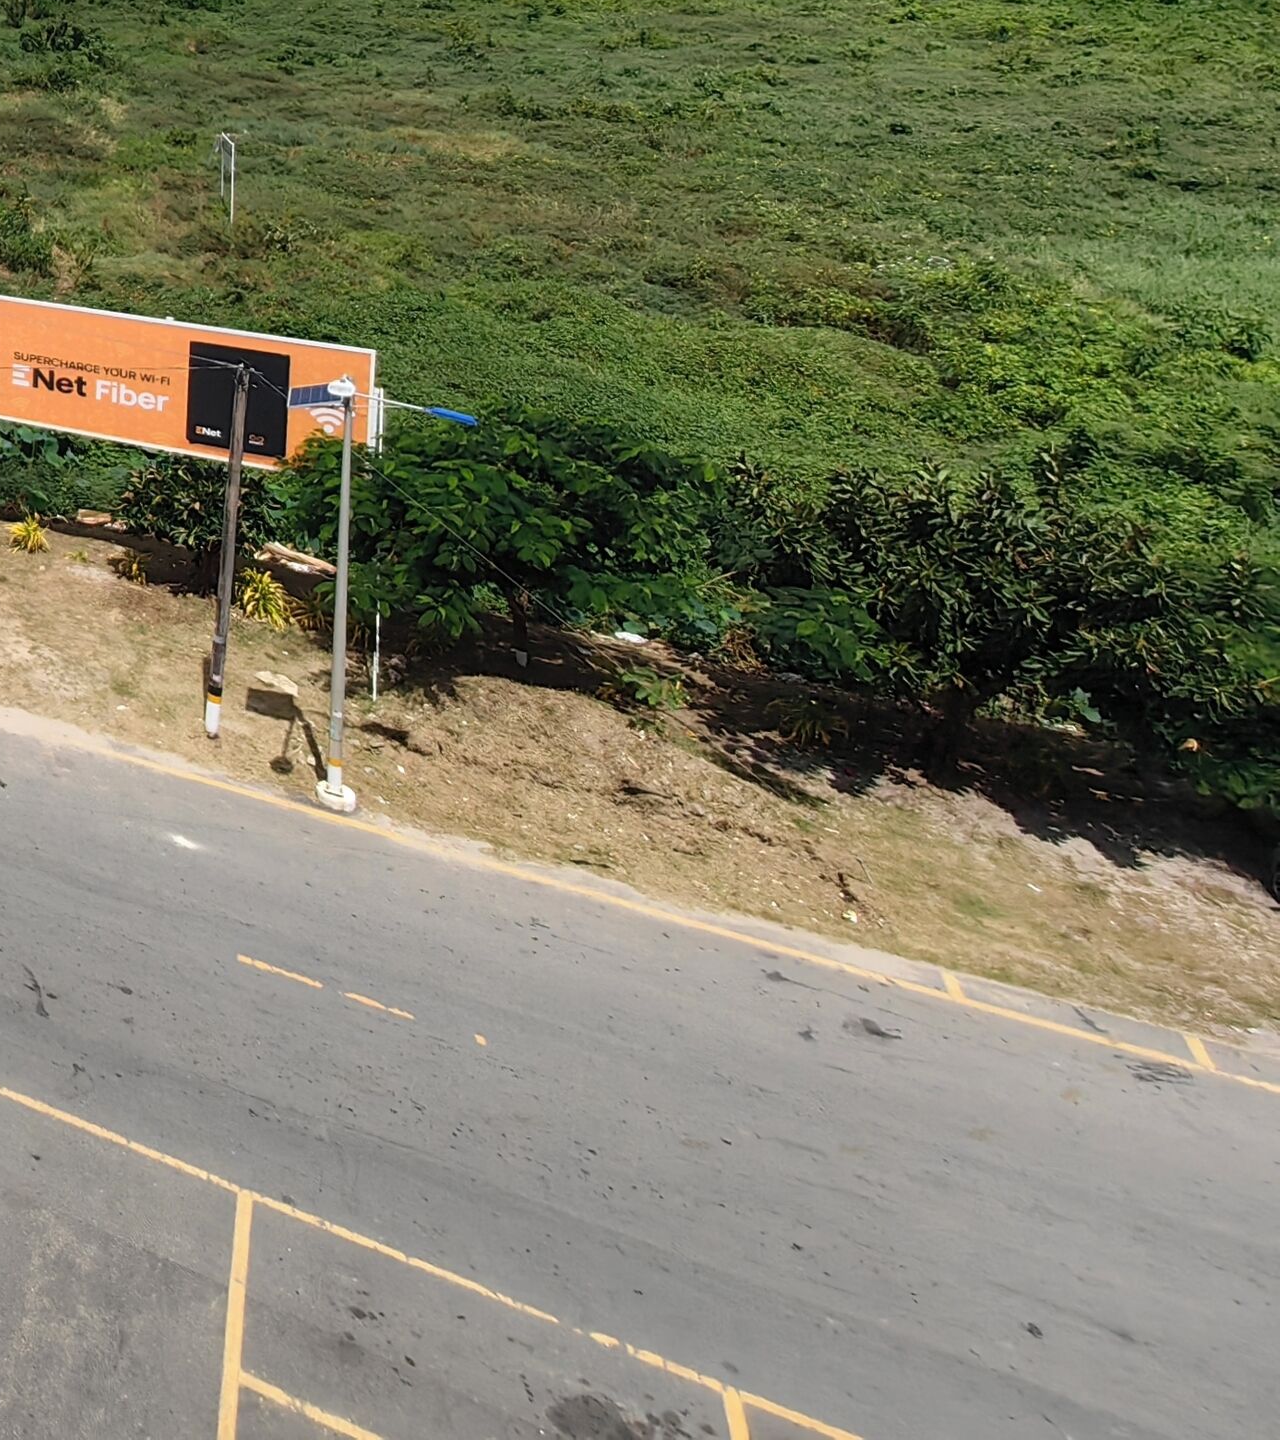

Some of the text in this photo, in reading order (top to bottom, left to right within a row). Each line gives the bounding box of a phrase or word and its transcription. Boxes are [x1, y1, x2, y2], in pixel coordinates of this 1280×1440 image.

[13, 351, 171, 386] SUPERCHARGE YOUR WI-FI
[11, 363, 169, 412] ENet Fiber
[195, 425, 222, 438] ENet
